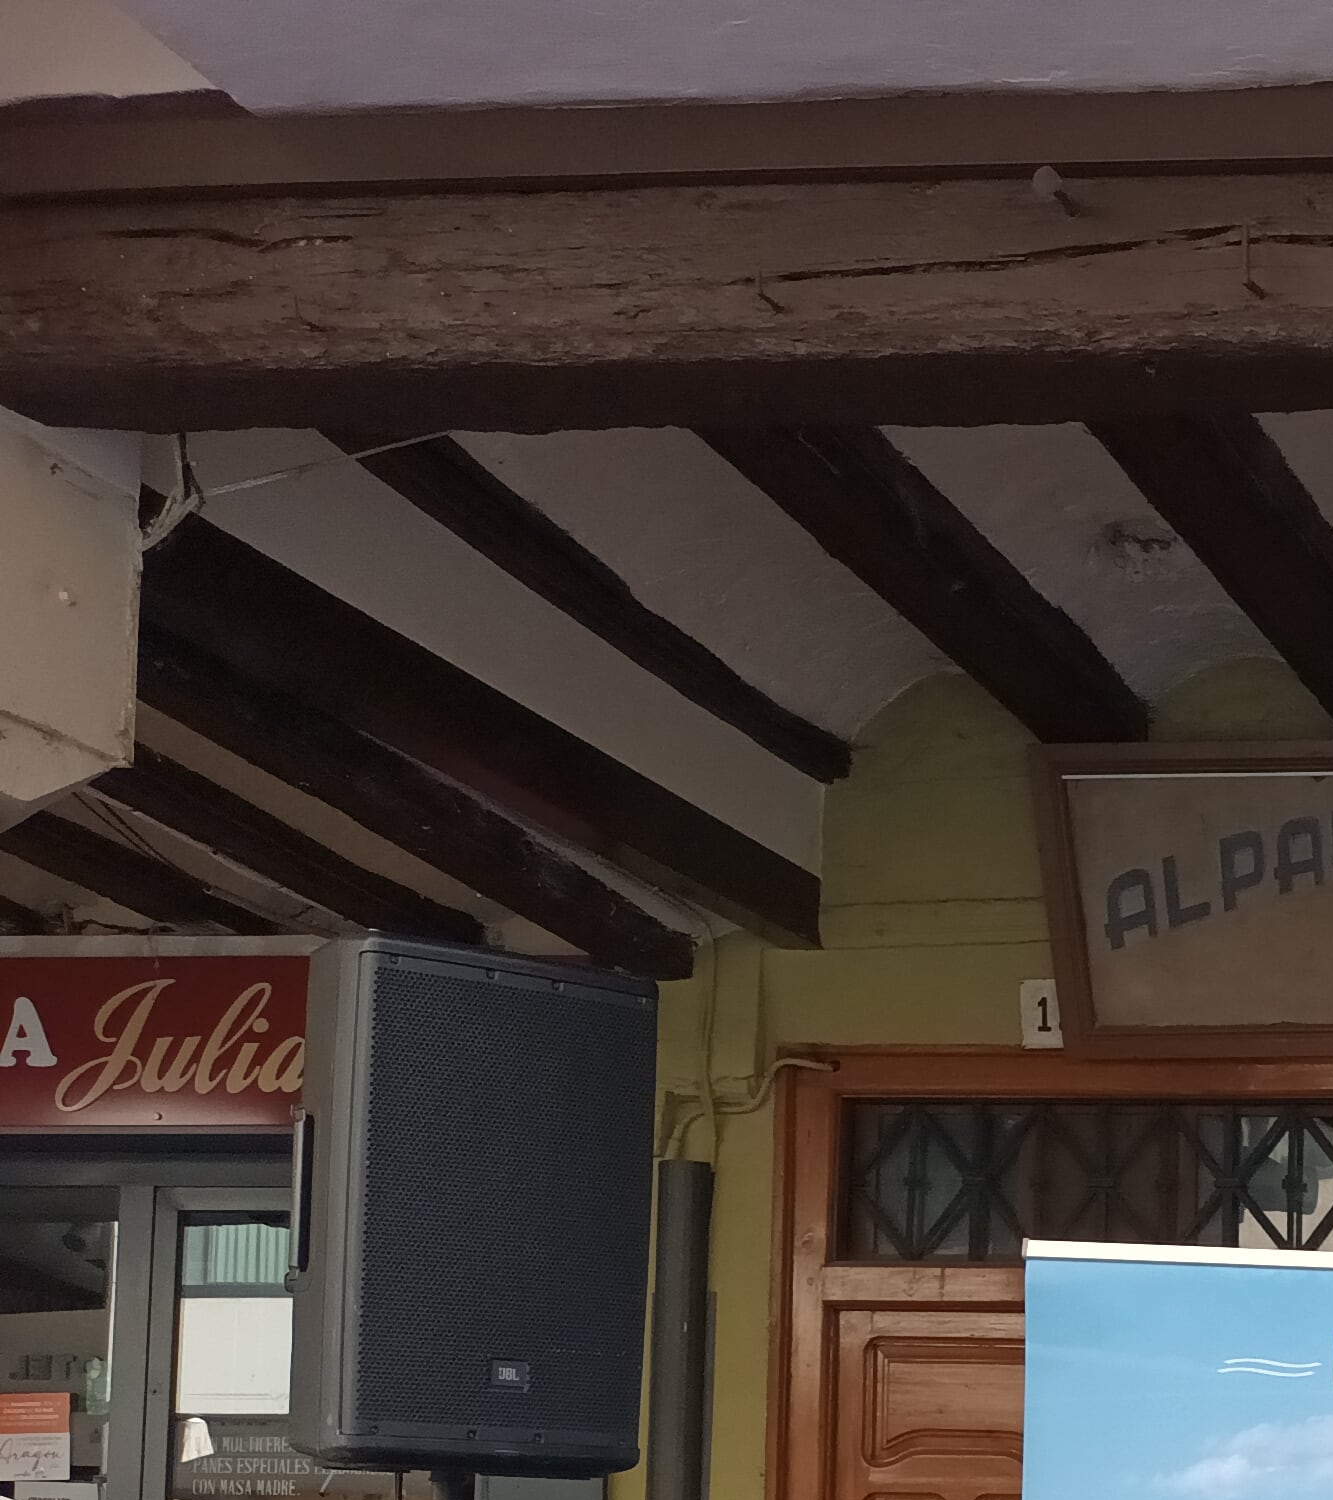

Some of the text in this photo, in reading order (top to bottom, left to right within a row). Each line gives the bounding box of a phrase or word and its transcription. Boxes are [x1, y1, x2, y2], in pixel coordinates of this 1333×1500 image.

[1036, 996, 1053, 1032] 1
[498, 1367, 520, 1381] JBL
[193, 1457, 233, 1474] PANES
[236, 1457, 311, 1475] ESPECIALES
[192, 1479, 215, 1496] CON
[219, 1480, 252, 1497] MASA
